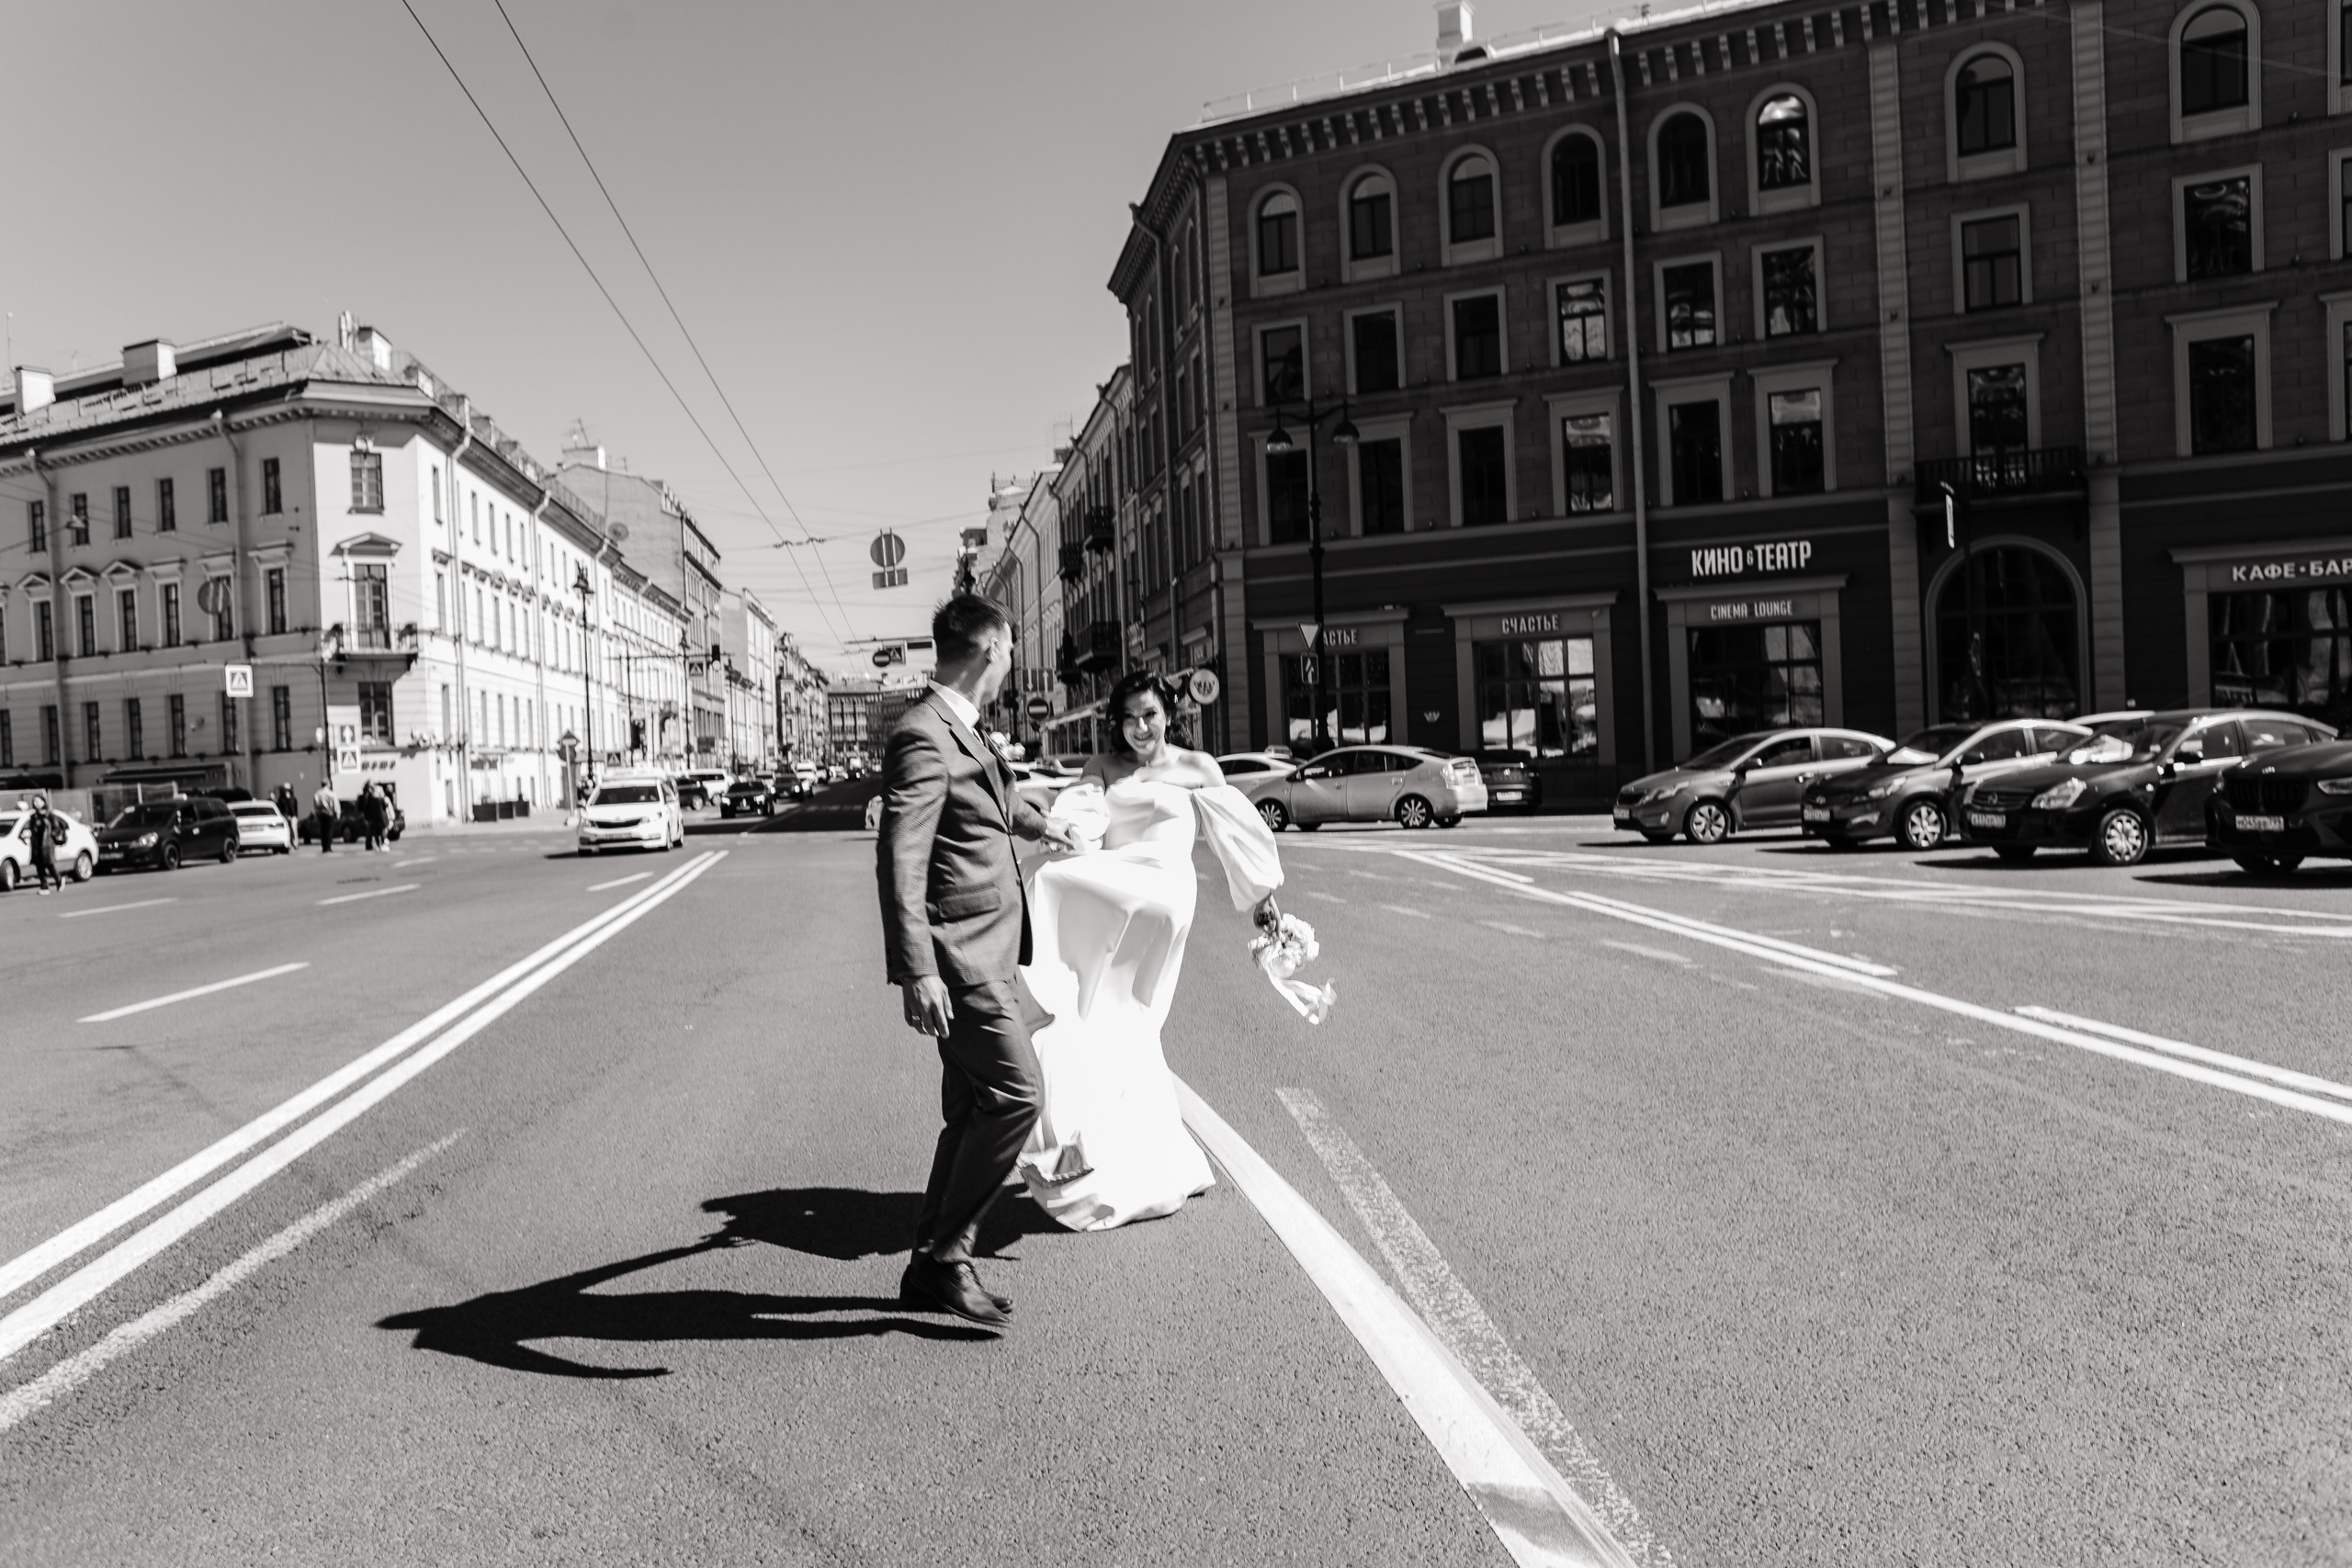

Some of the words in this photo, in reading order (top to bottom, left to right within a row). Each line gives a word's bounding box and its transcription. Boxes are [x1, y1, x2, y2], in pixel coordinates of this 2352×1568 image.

[1691, 546, 1743, 577] КИНО
[1754, 540, 1812, 571] ТЕАТР
[2232, 562, 2296, 582] КАФЕ
[1710, 602, 1747, 621] CINEMA
[1753, 599, 1793, 618] LOUNGE
[1501, 614, 1559, 635] СЧАСТЬЕ
[1323, 627, 1358, 647] АСТЬЕ
